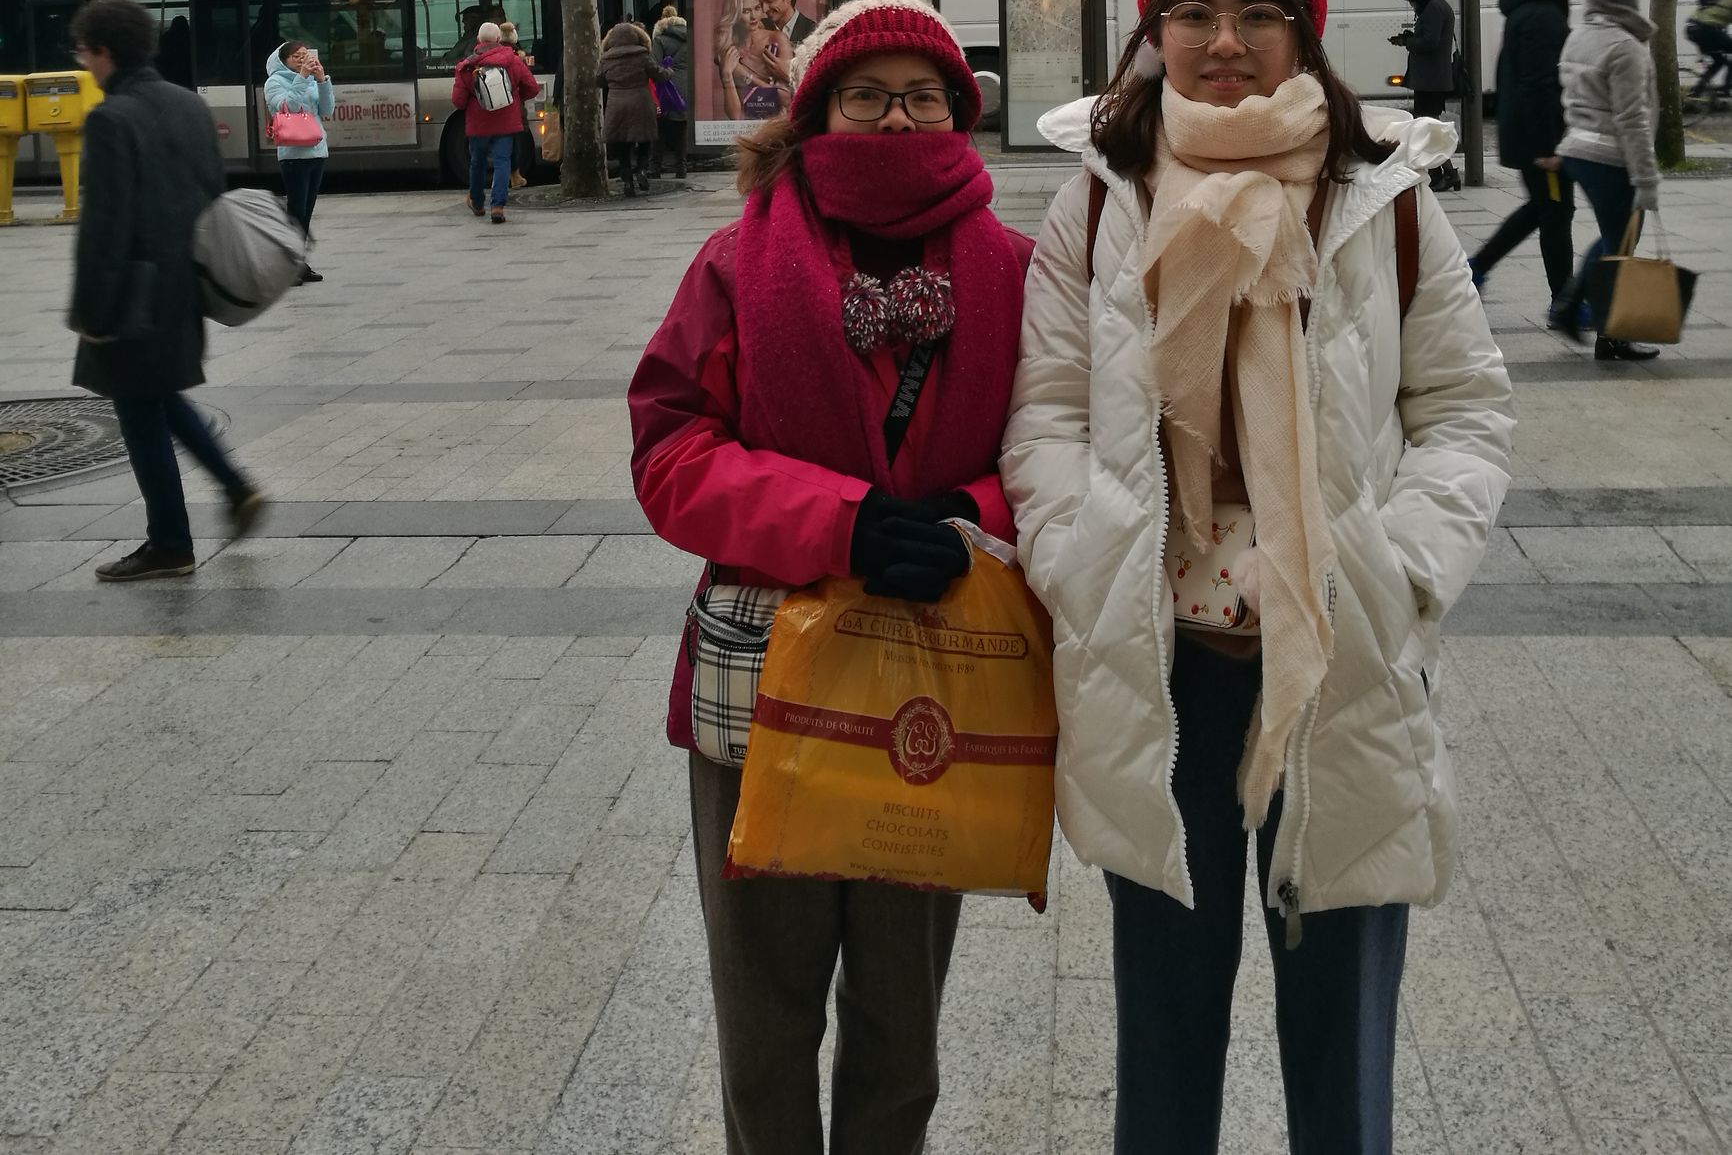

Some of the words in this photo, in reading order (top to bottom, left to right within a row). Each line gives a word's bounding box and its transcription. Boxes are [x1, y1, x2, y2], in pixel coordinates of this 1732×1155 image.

[842, 614, 863, 631] LA
[870, 619, 914, 639] CURE
[918, 631, 1020, 654] GOURMANDE
[956, 662, 976, 674] 1989
[784, 712, 824, 728] PRODUITS
[826, 720, 837, 730] DE
[839, 721, 875, 736] QUALITÉ
[883, 802, 941, 821] BISCUITS
[866, 819, 950, 841] CHOCOLATS
[862, 837, 945, 857] CONFISERIES
